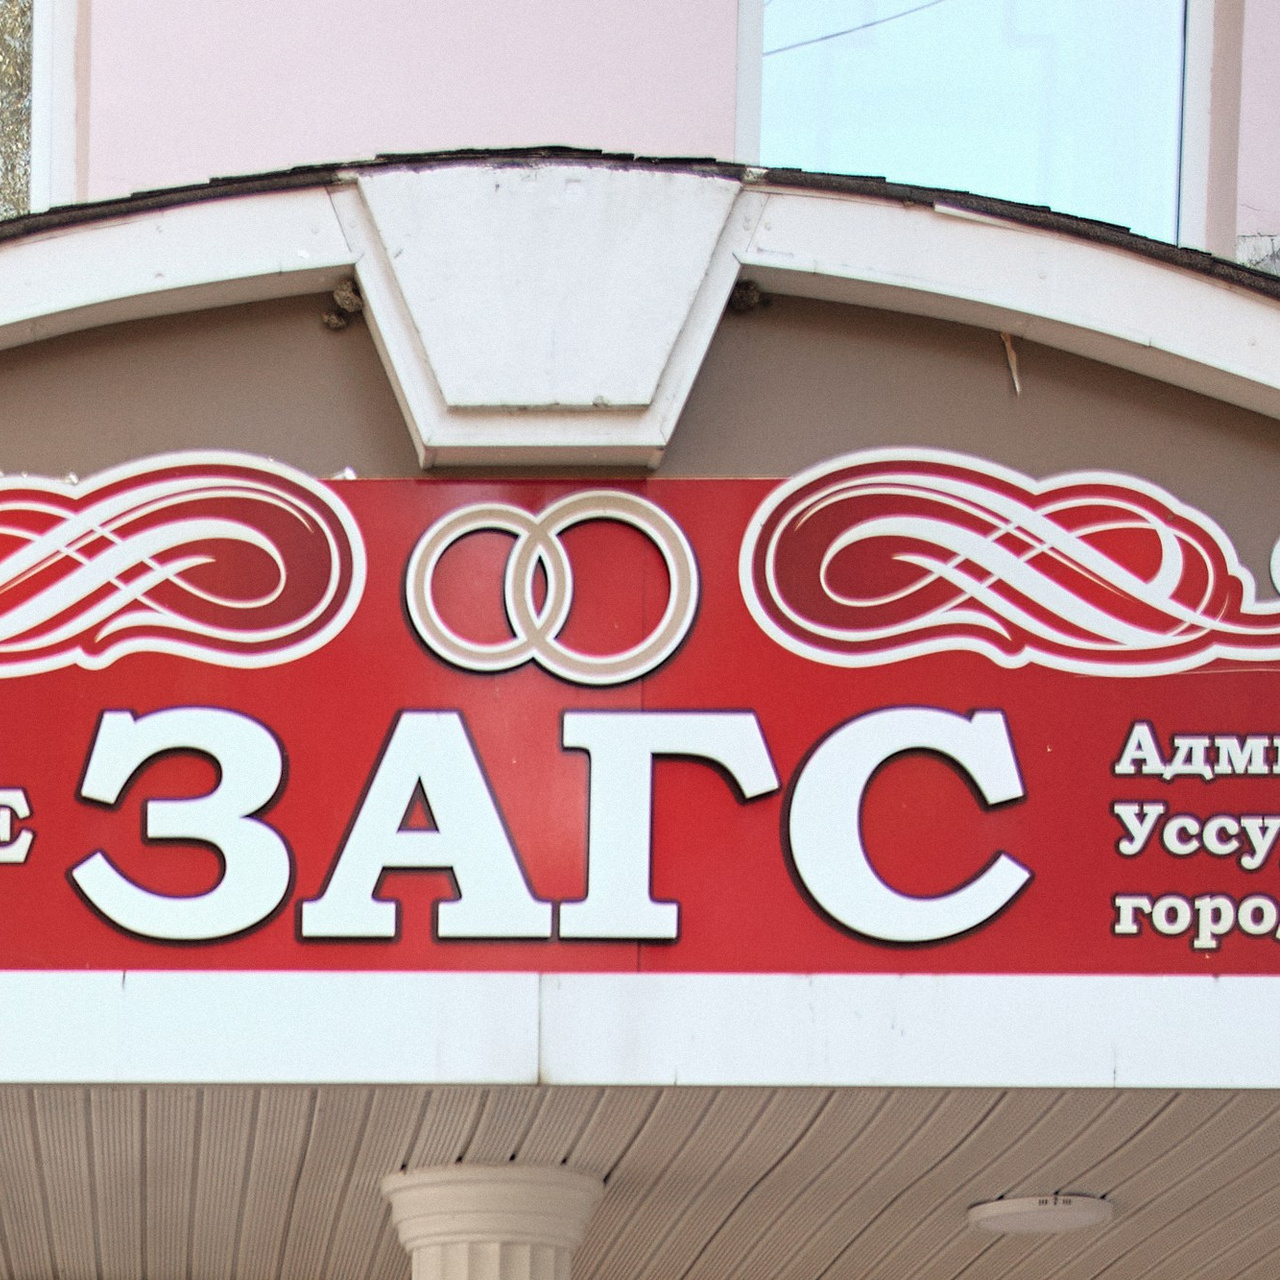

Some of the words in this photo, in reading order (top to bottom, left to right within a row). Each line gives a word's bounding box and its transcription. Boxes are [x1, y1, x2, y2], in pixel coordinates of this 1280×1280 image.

[1114, 721, 1280, 780] Адм
[71, 706, 1032, 941] ЗАГС
[1114, 894, 1280, 949] горо
